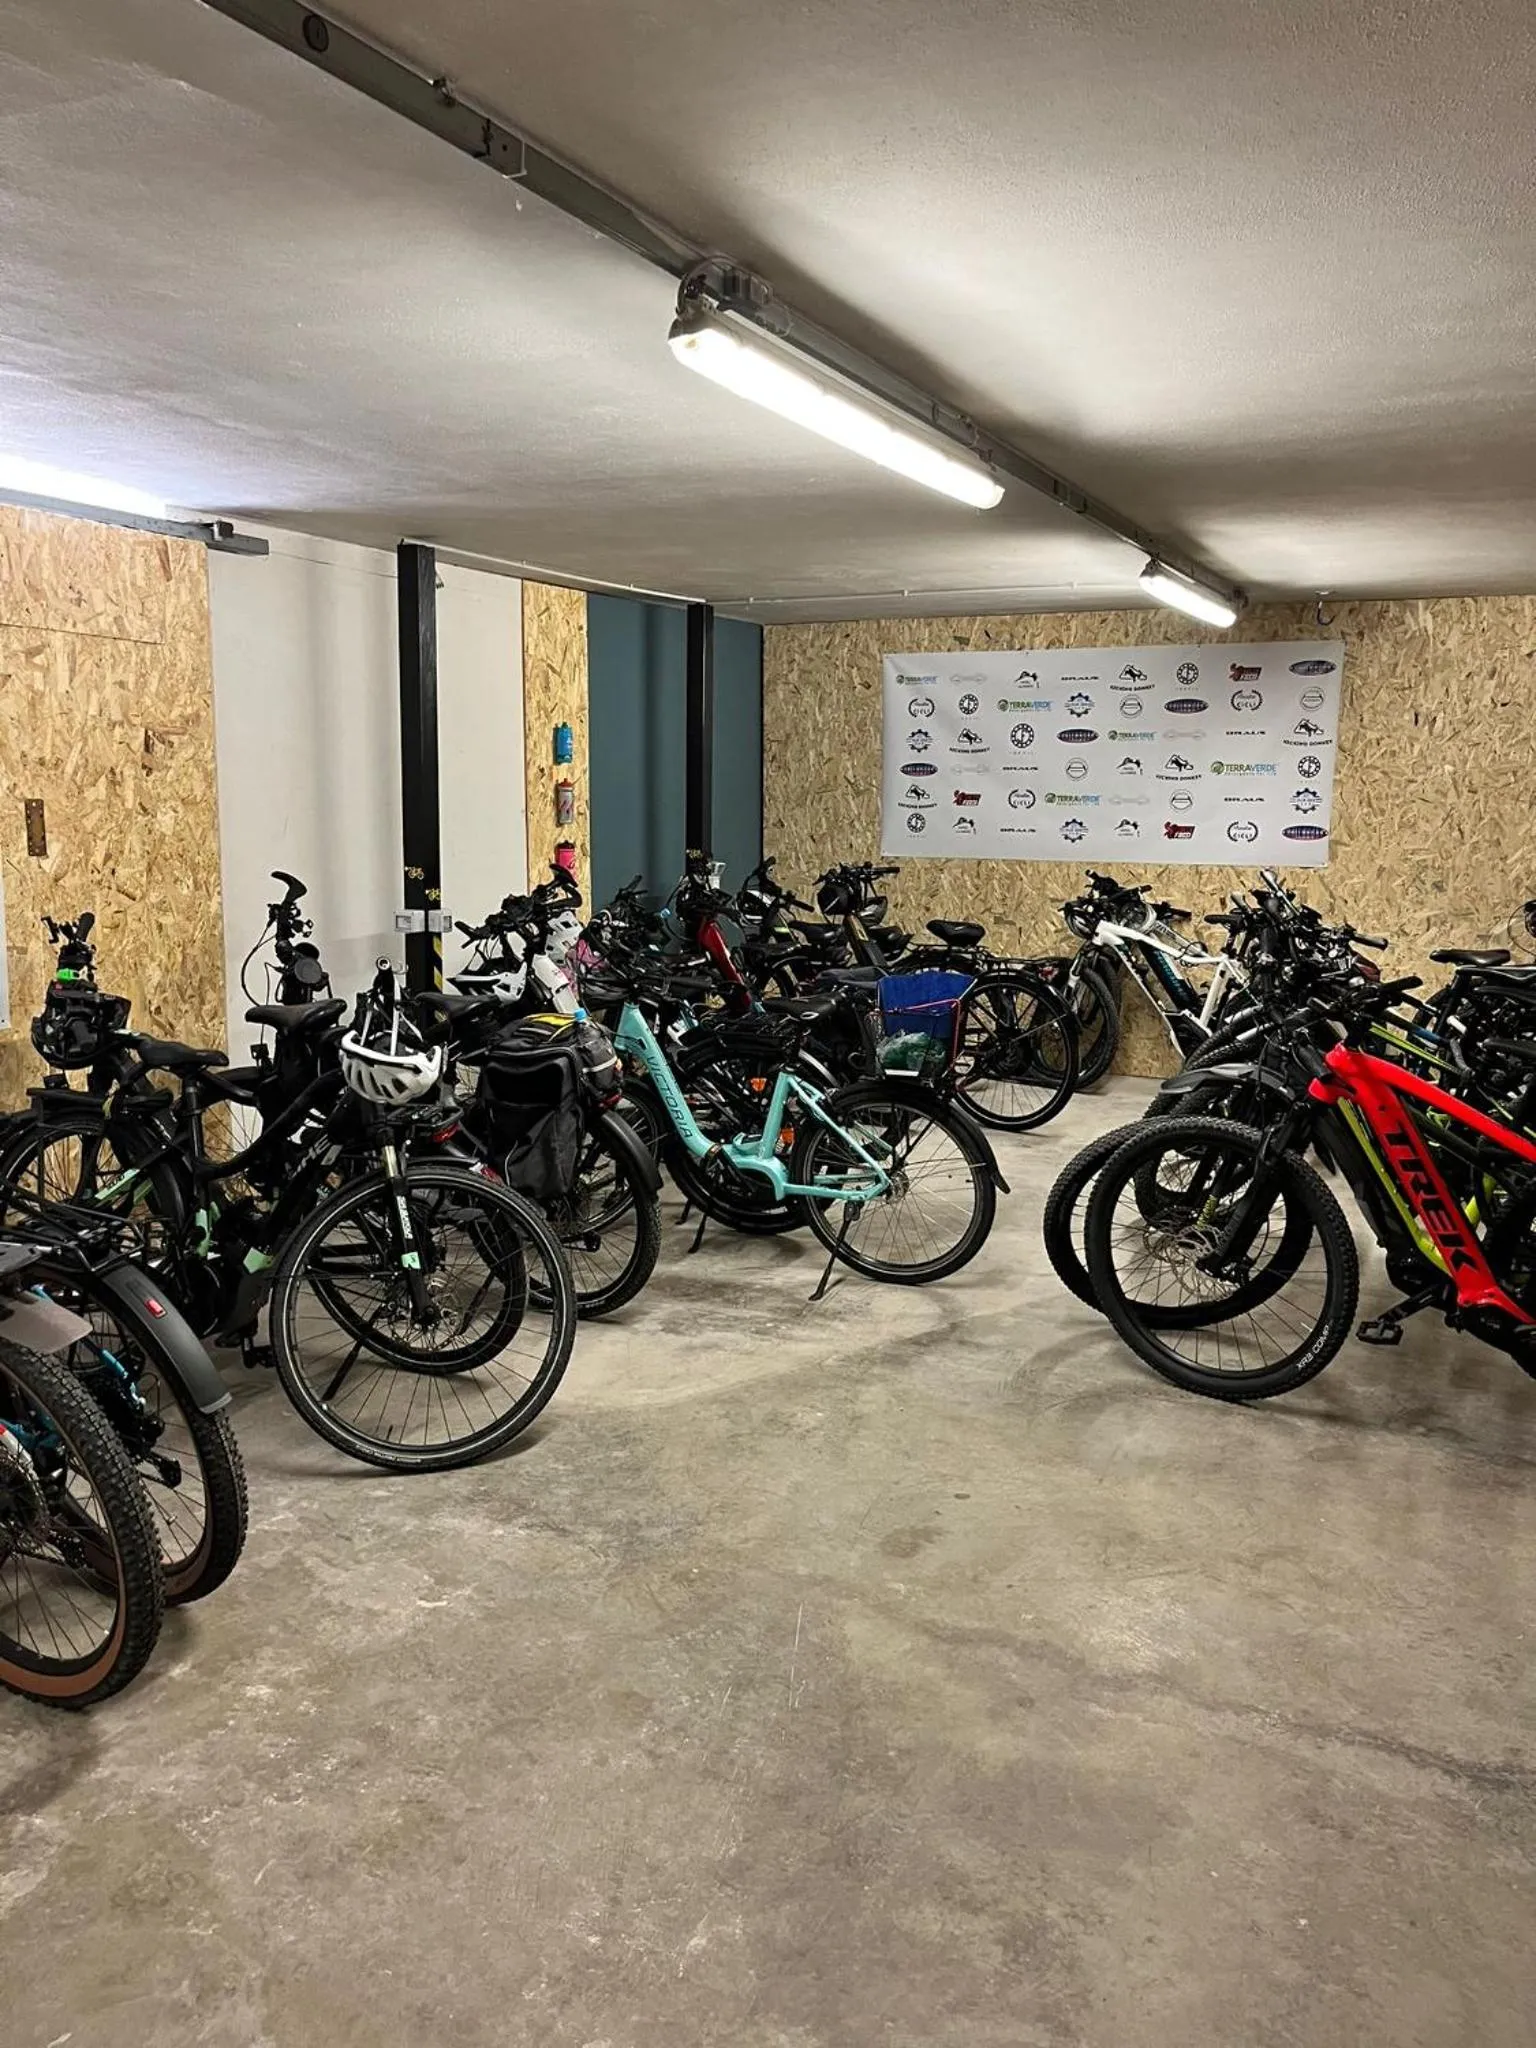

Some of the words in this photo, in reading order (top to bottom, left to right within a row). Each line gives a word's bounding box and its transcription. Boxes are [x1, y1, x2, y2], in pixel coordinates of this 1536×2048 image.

[1225, 763, 1277, 772] TERRAVERDE
[646, 1056, 693, 1138] VICTORIA
[1383, 1122, 1480, 1273] TREK
[1312, 1325, 1329, 1353] COMP
